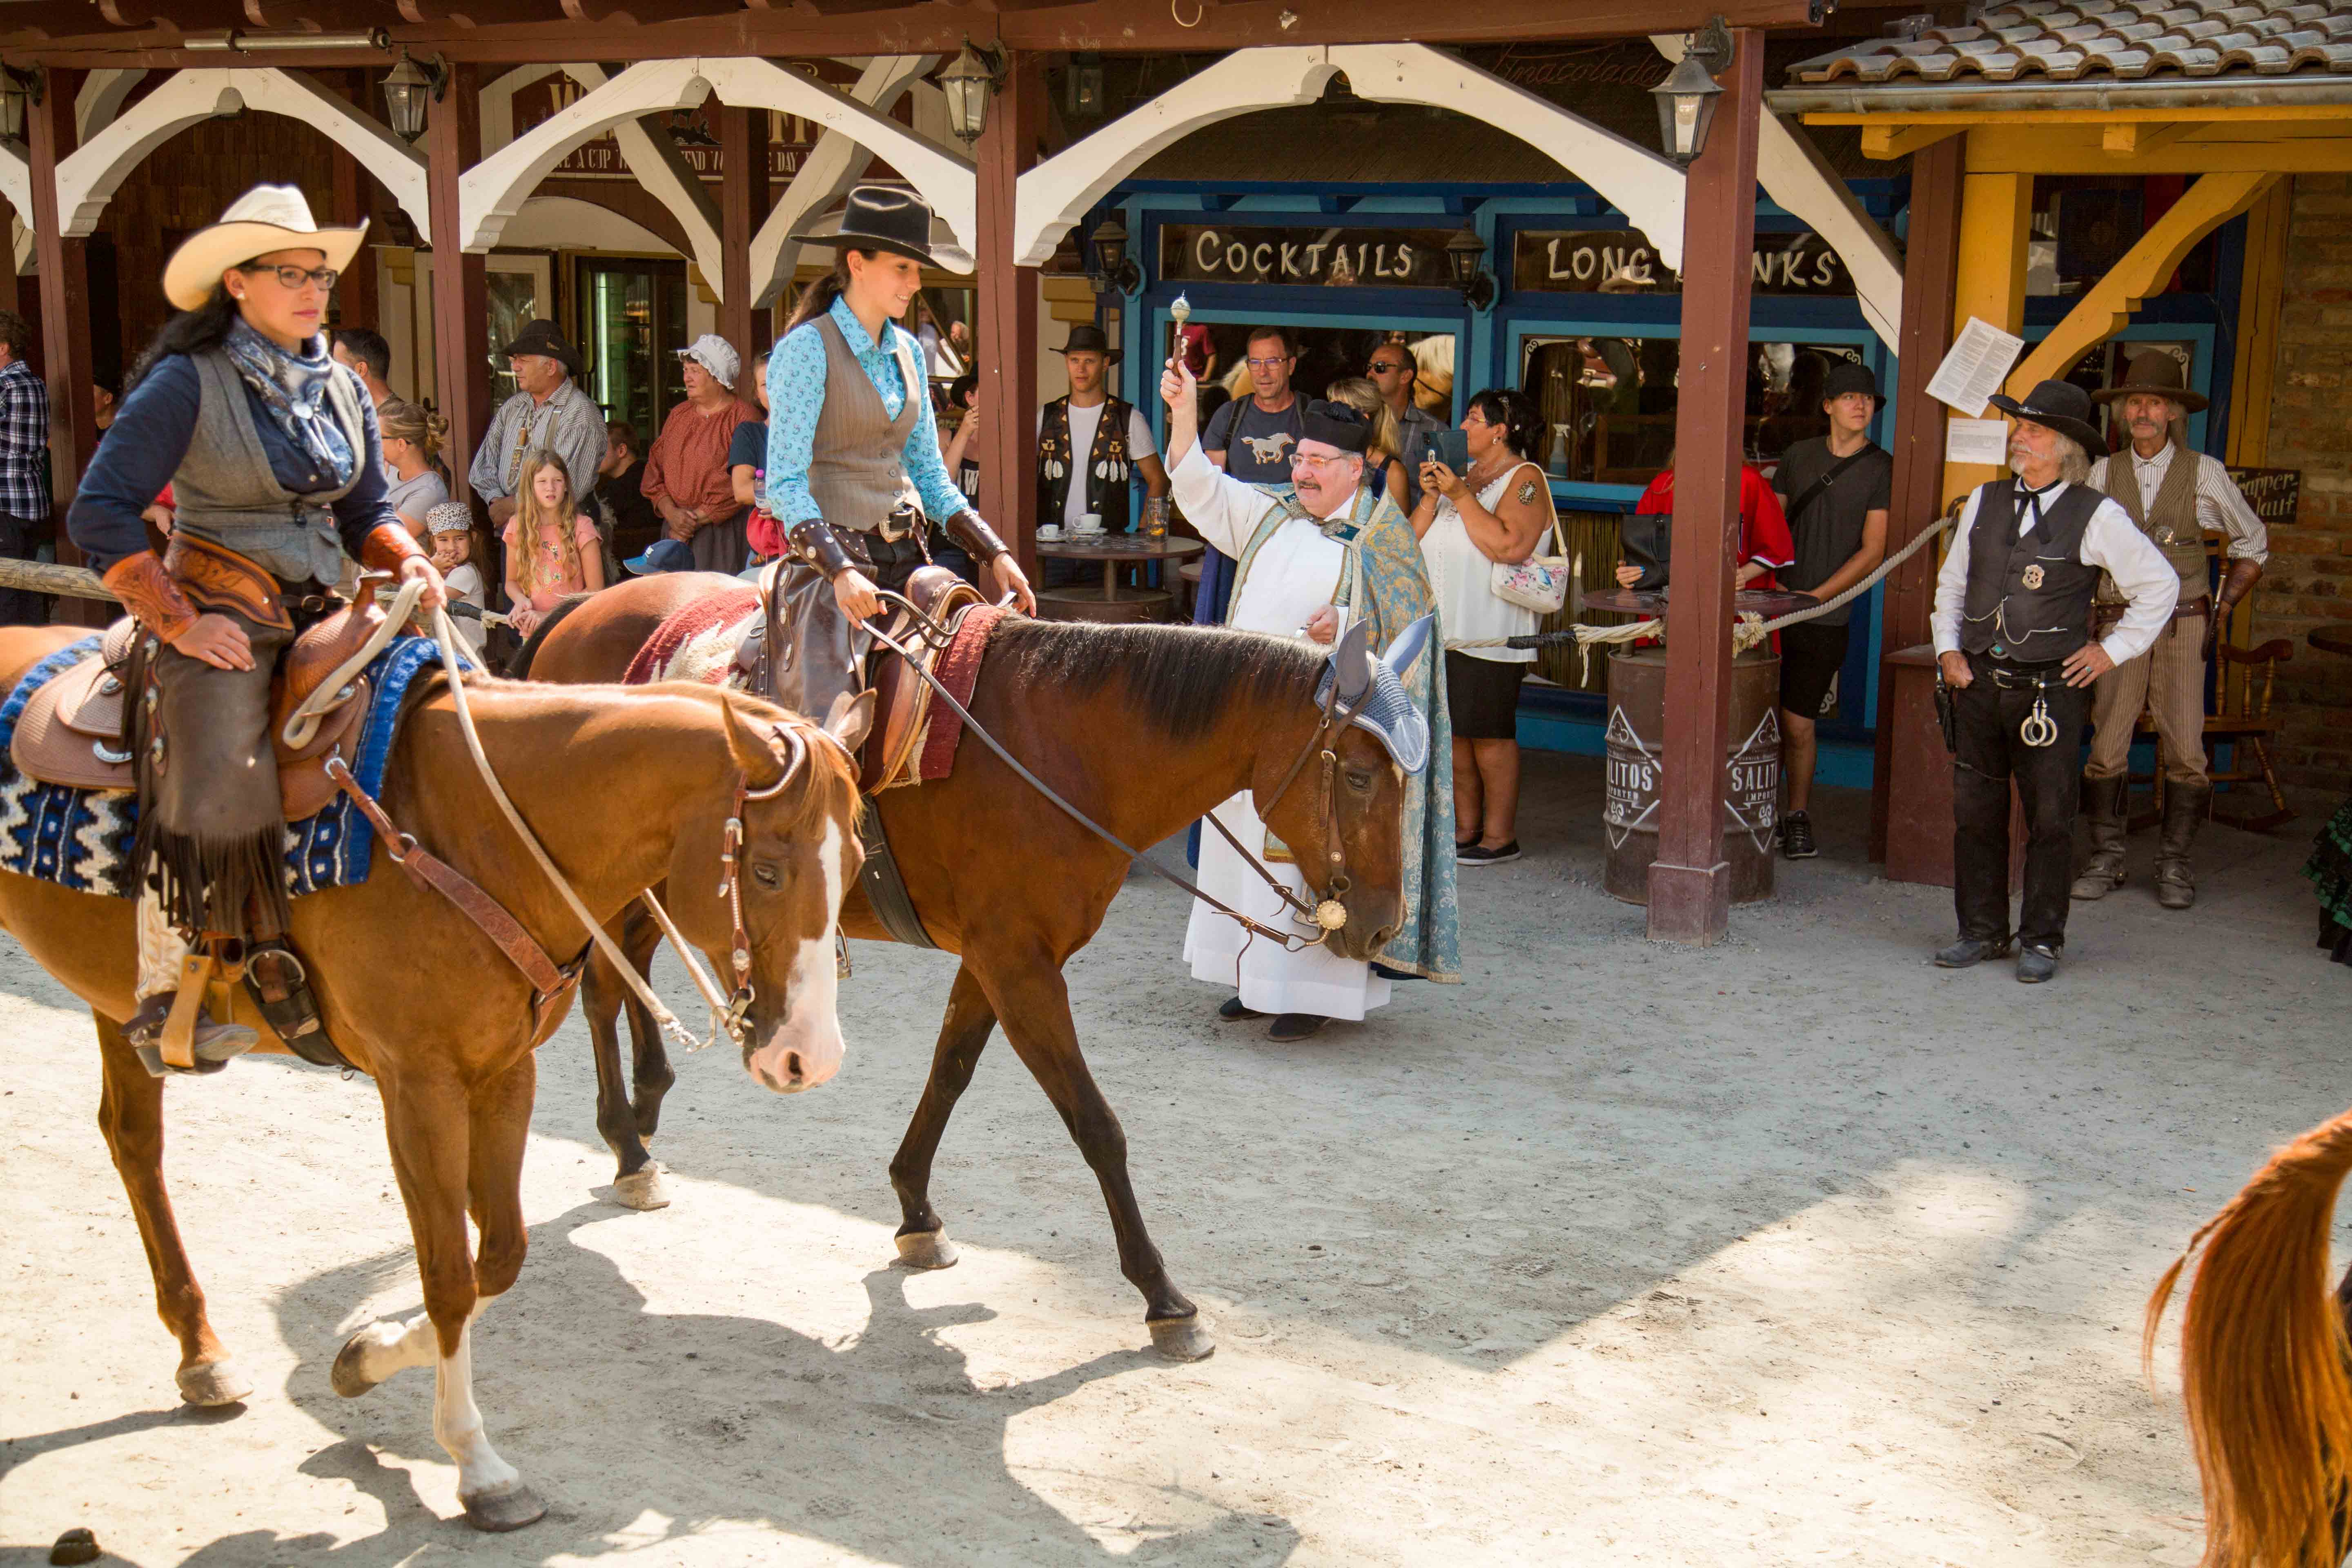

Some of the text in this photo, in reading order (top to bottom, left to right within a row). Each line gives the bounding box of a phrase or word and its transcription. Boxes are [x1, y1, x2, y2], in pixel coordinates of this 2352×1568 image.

[576, 149, 585, 168] A
[588, 149, 611, 169] CUP
[777, 151, 798, 172] DAY
[1196, 231, 1413, 278] COCKTAILS
[1548, 238, 1652, 281] LONG
